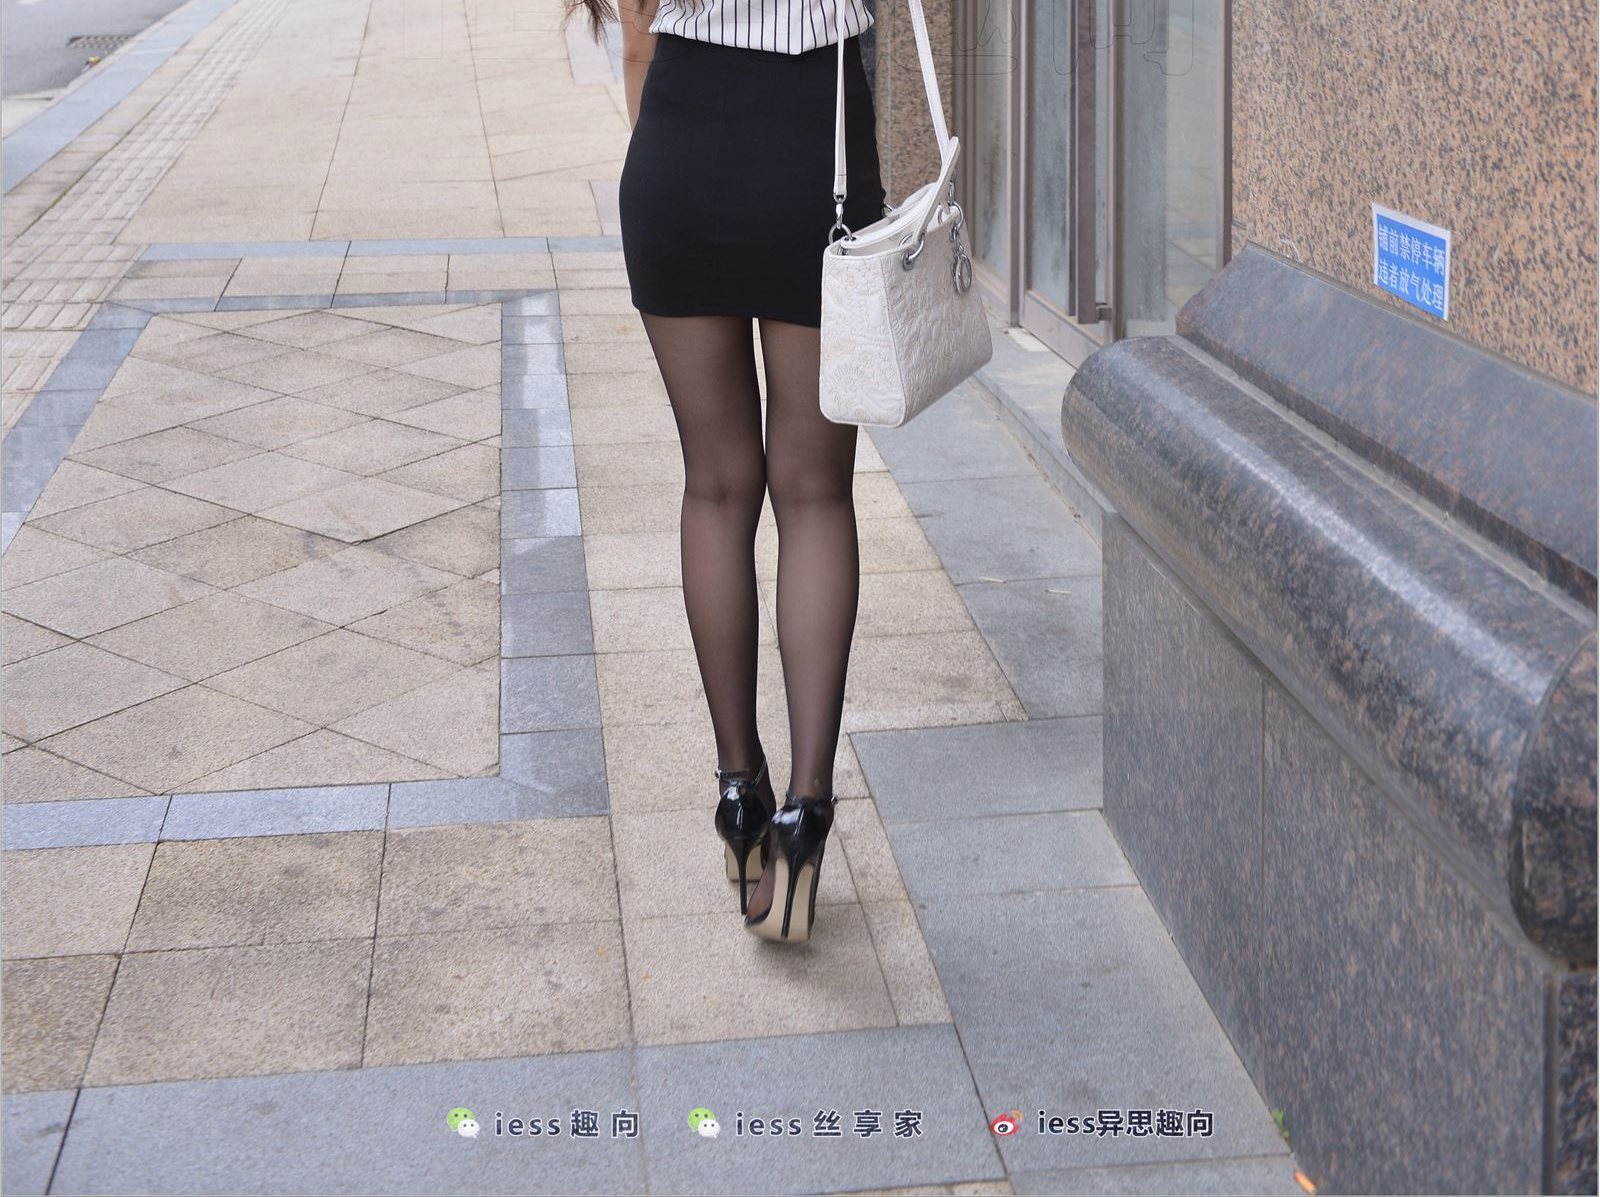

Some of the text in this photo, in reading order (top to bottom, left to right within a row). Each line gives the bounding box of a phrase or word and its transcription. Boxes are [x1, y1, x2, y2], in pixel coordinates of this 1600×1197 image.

[1379, 258, 1444, 311] 违者放气处理
